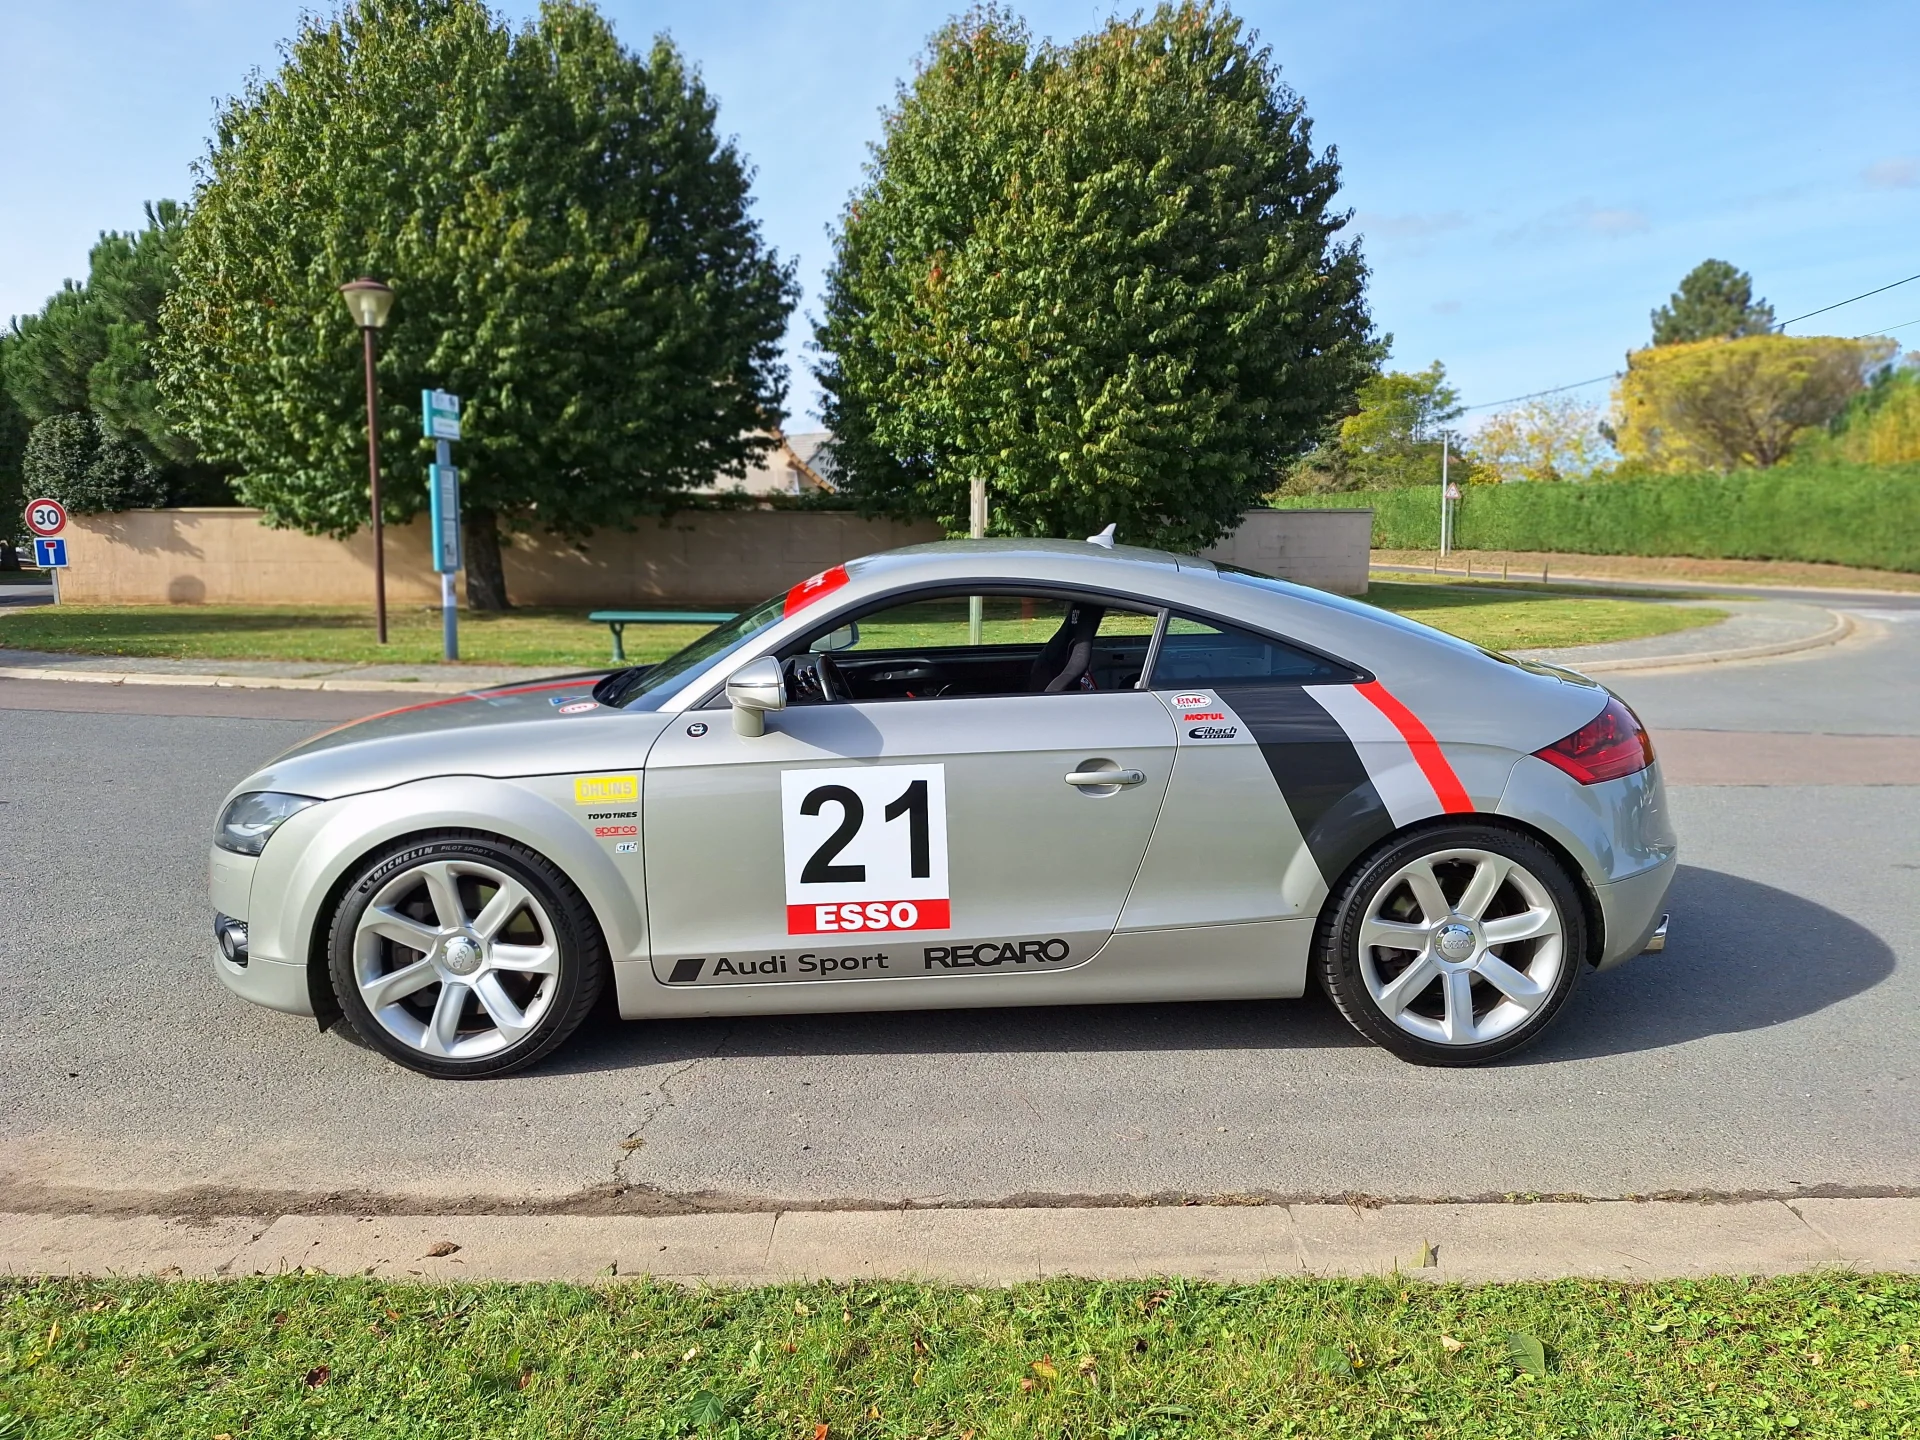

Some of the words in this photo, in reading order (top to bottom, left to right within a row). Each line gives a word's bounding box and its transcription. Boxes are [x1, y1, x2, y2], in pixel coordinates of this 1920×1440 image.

[34, 509, 59, 526] 30
[1183, 713, 1224, 721] MOTUL
[1188, 726, 1238, 739] Eibach
[581, 780, 633, 797] ÖHLINS
[613, 811, 638, 819] TIRES
[595, 825, 637, 837] sparco
[800, 780, 930, 883] 21
[373, 846, 433, 880] MICHELIN
[463, 846, 488, 855] SPORT
[815, 902, 918, 931] ESSO
[1342, 894, 1362, 958] MICHELIN
[1363, 872, 1377, 891] PILOT
[1378, 855, 1397, 872] SPORT
[923, 938, 1070, 969] RECARO
[712, 955, 787, 976] Audi
[798, 953, 889, 975] Sport
